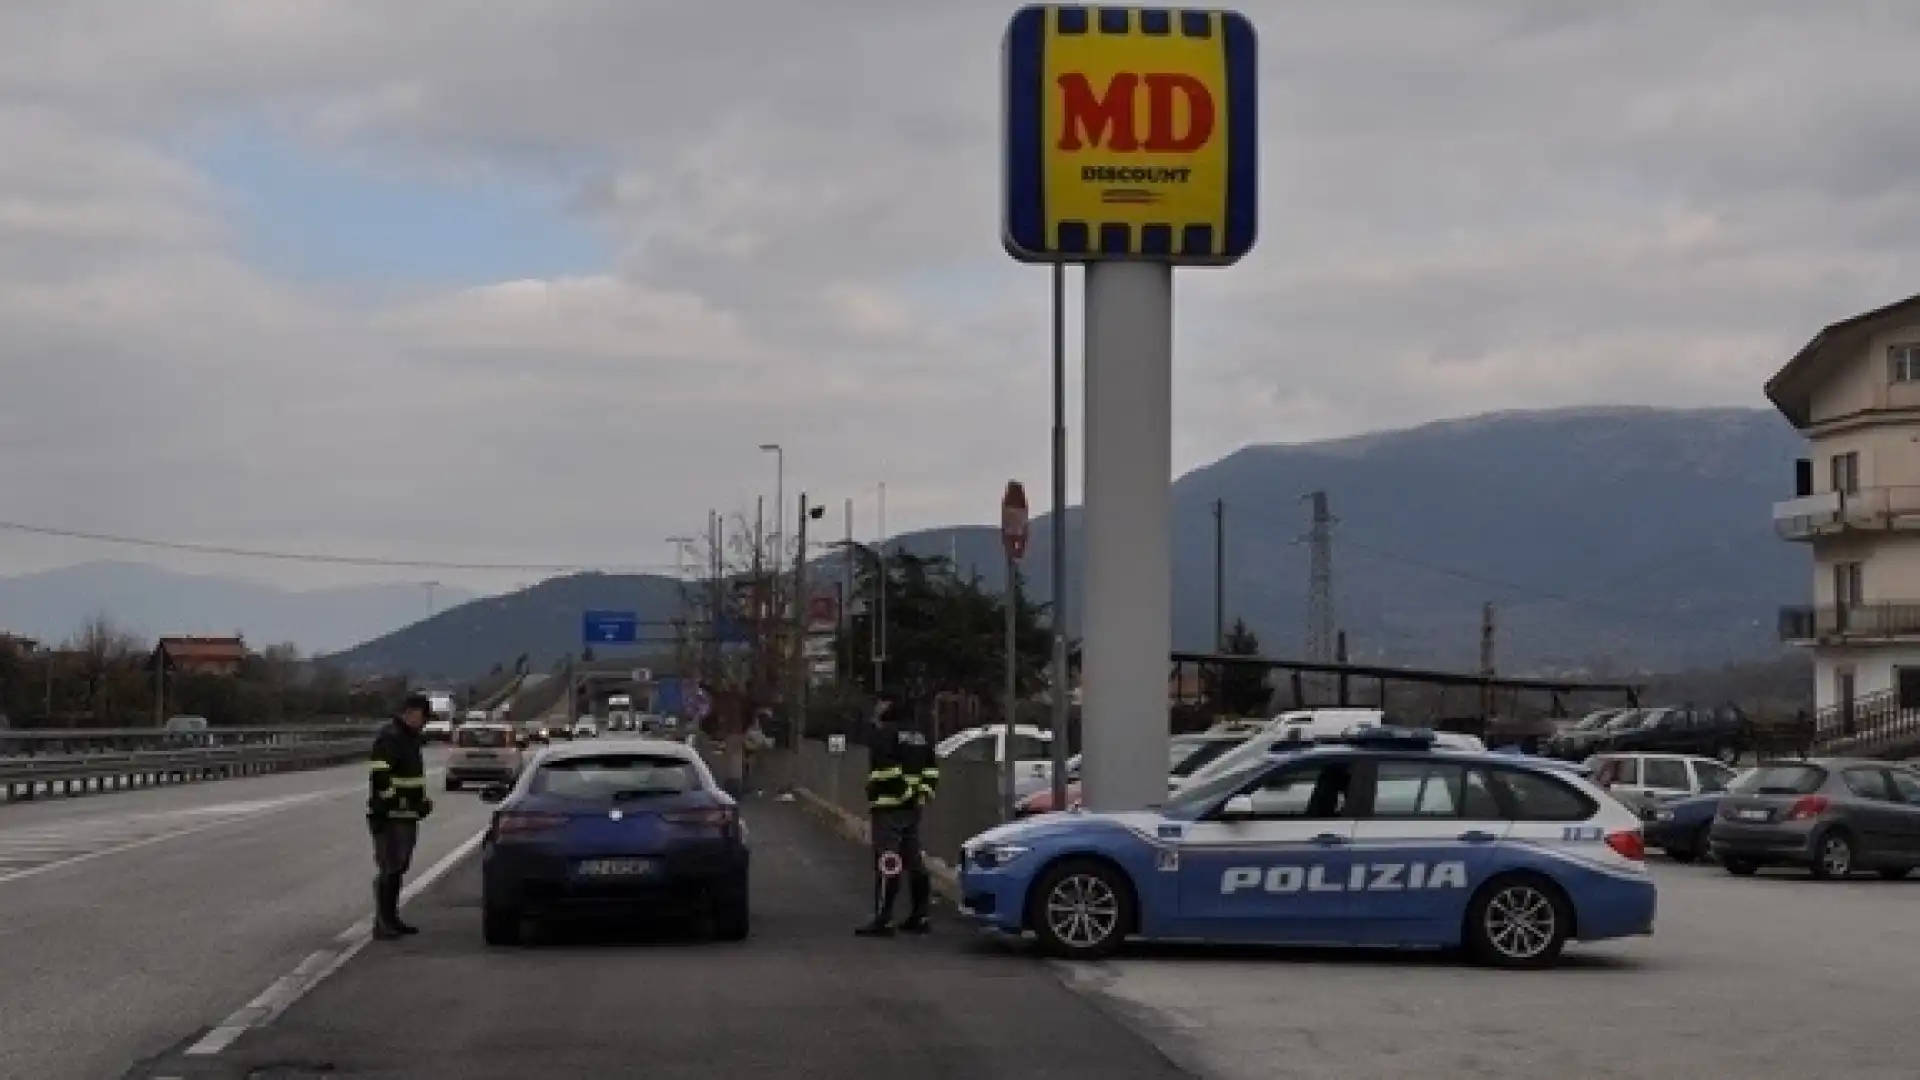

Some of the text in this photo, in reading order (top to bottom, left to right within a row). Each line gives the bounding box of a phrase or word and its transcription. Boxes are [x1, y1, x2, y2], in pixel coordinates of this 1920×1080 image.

[1058, 72, 1214, 152] MD
[1081, 166, 1191, 183] DISCOUNT
[1221, 861, 1467, 894] POLIZIA
